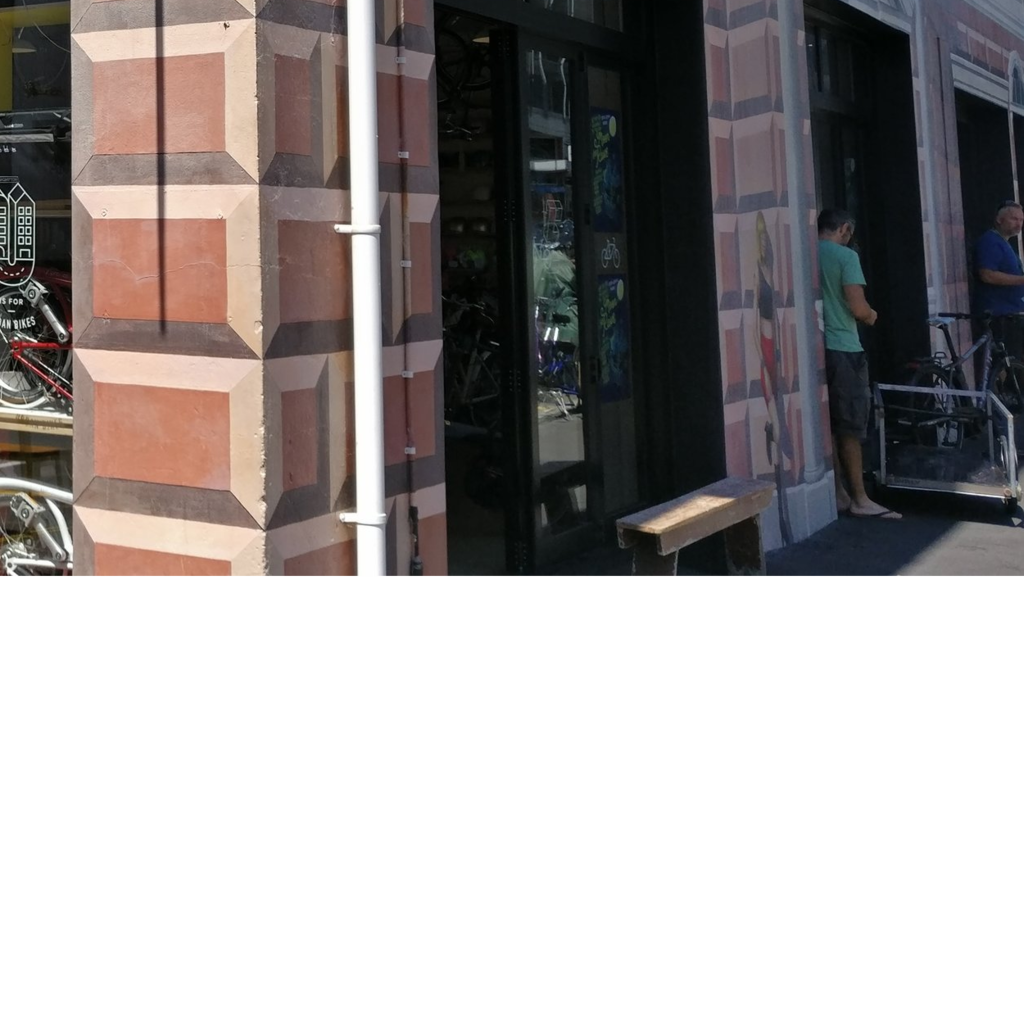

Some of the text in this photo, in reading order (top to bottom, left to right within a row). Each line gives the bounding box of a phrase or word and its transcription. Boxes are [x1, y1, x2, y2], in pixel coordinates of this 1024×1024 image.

[0, 297, 24, 306] IS FOR
[13, 315, 36, 330] BIKES
